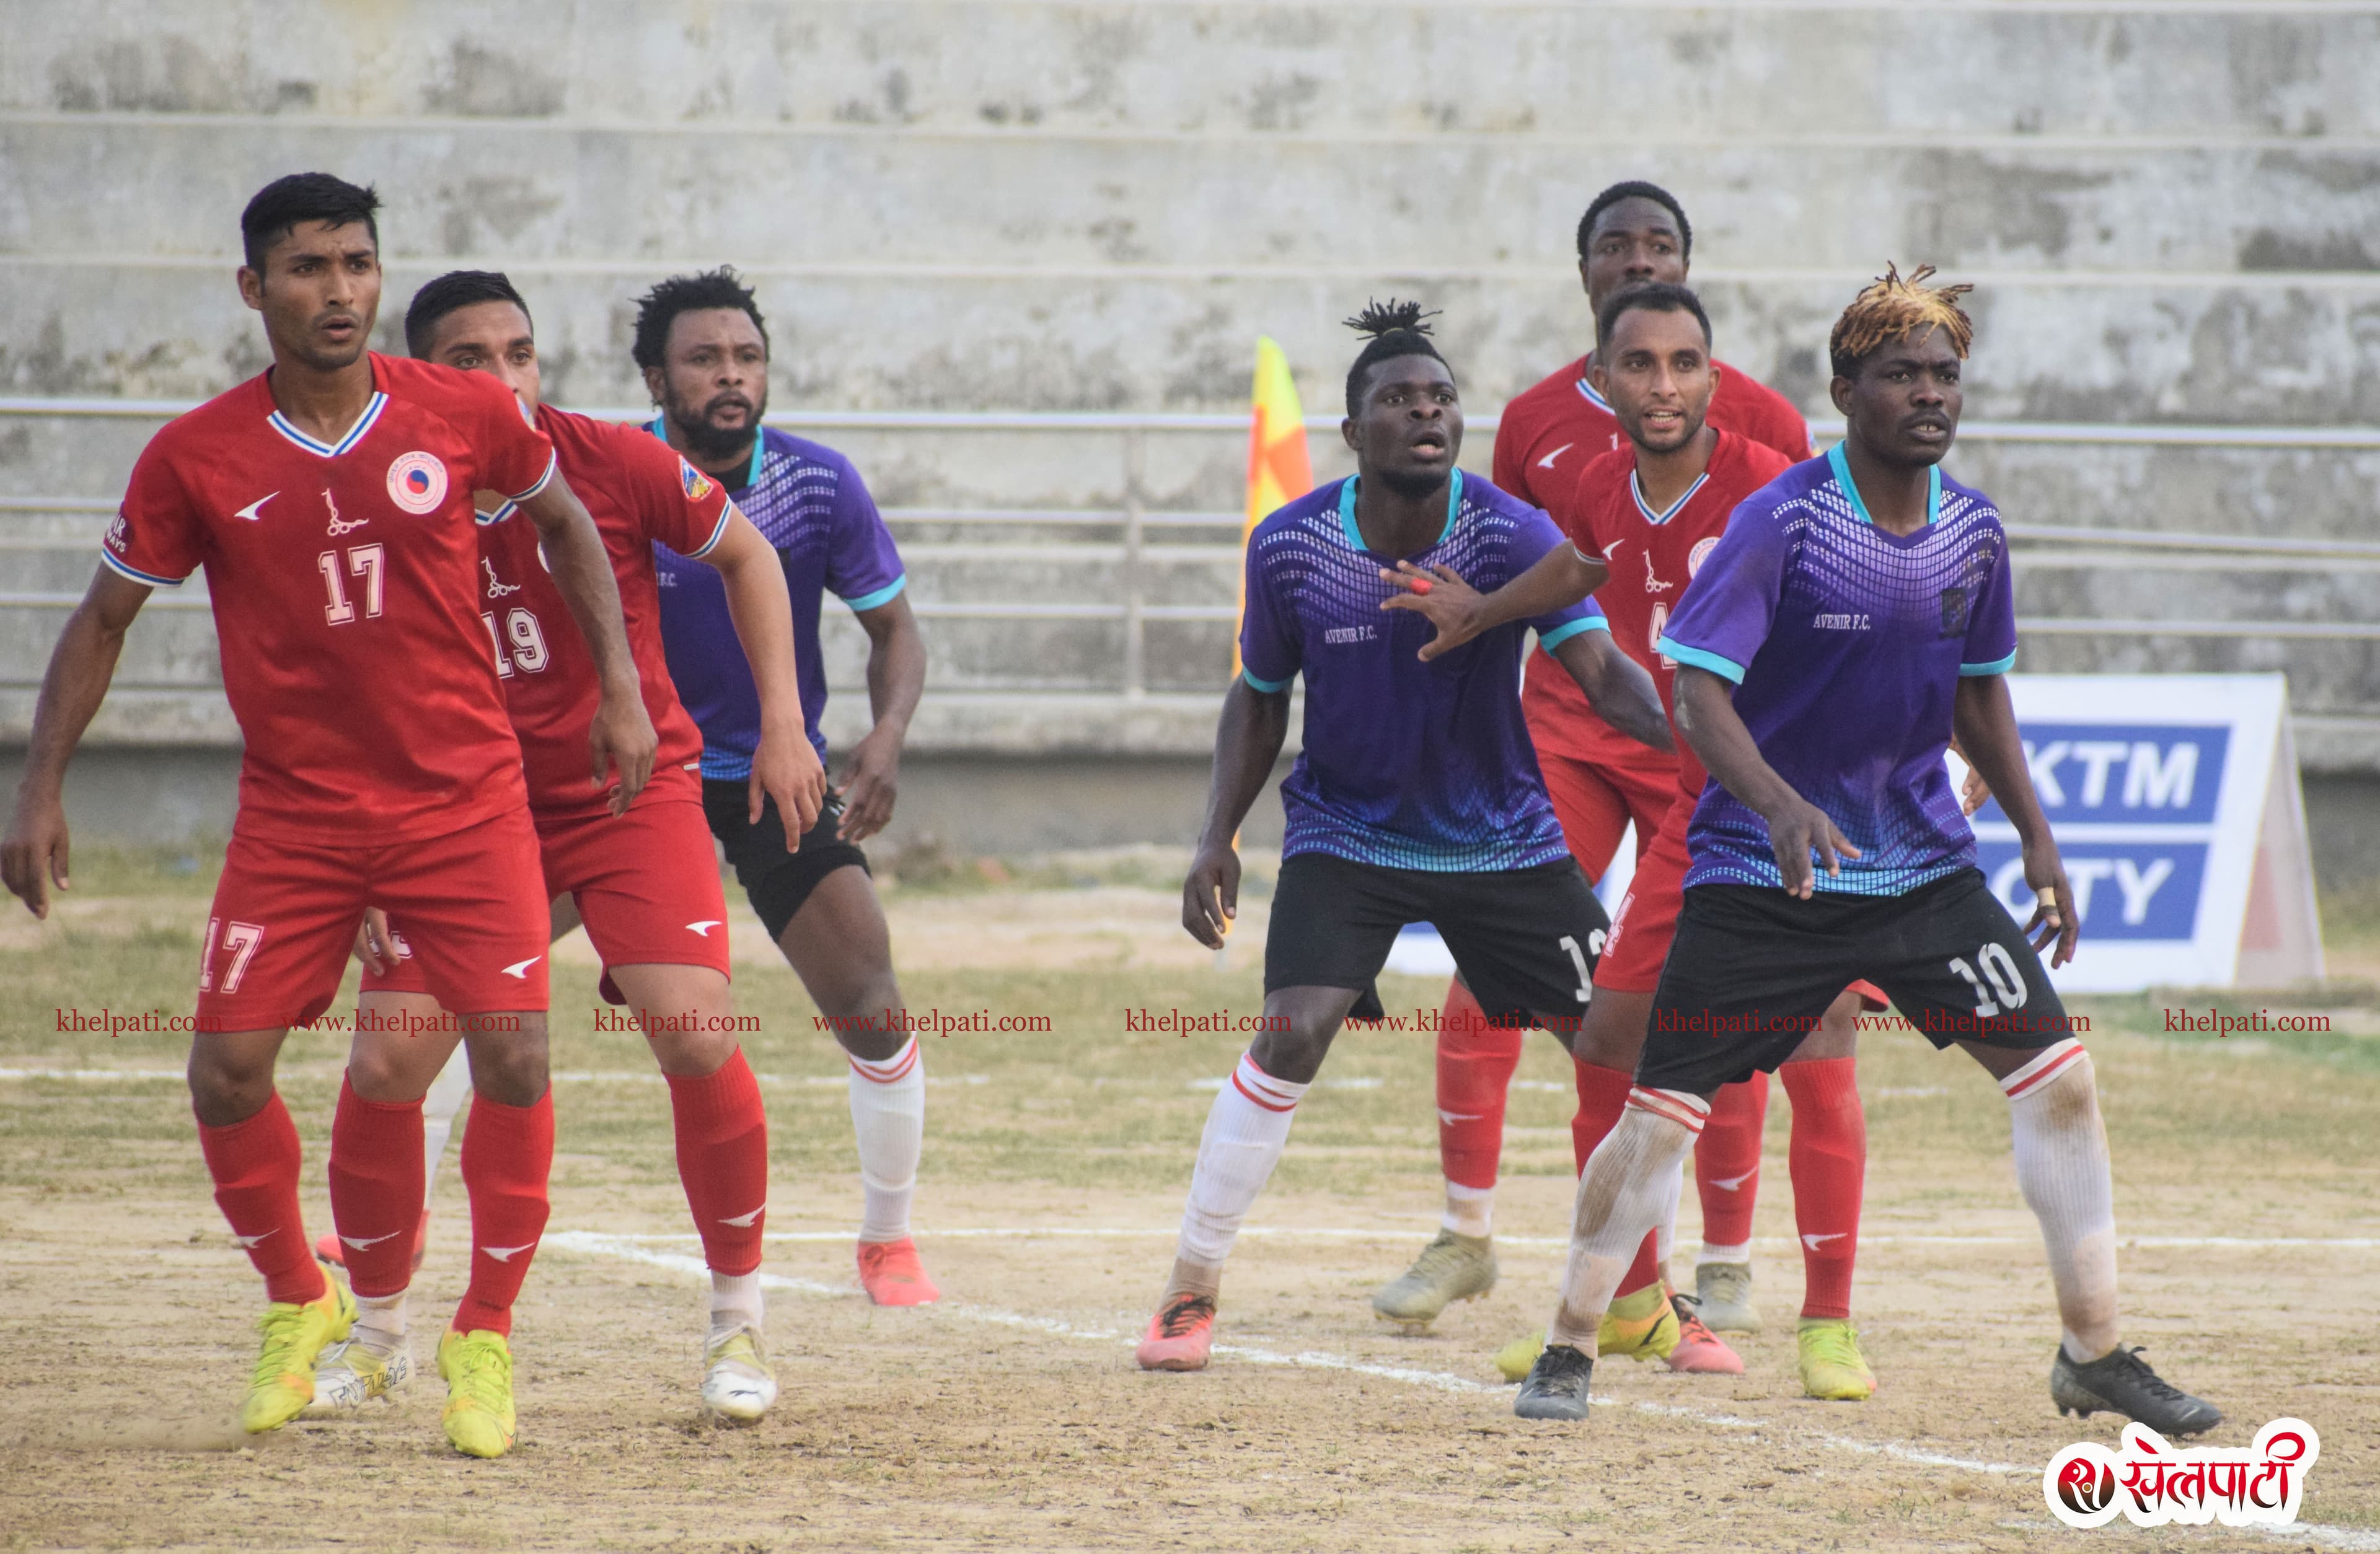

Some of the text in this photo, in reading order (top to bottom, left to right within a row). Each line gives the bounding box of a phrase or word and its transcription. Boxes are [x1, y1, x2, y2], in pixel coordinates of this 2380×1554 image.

[317, 543, 384, 626] 17
[1325, 625, 1377, 644] AVENIR F.C.
[1813, 613, 1871, 630] AVENIR F.C.
[2021, 740, 2200, 809] KTM
[199, 918, 264, 994] 17
[1949, 942, 2028, 1017] 10
